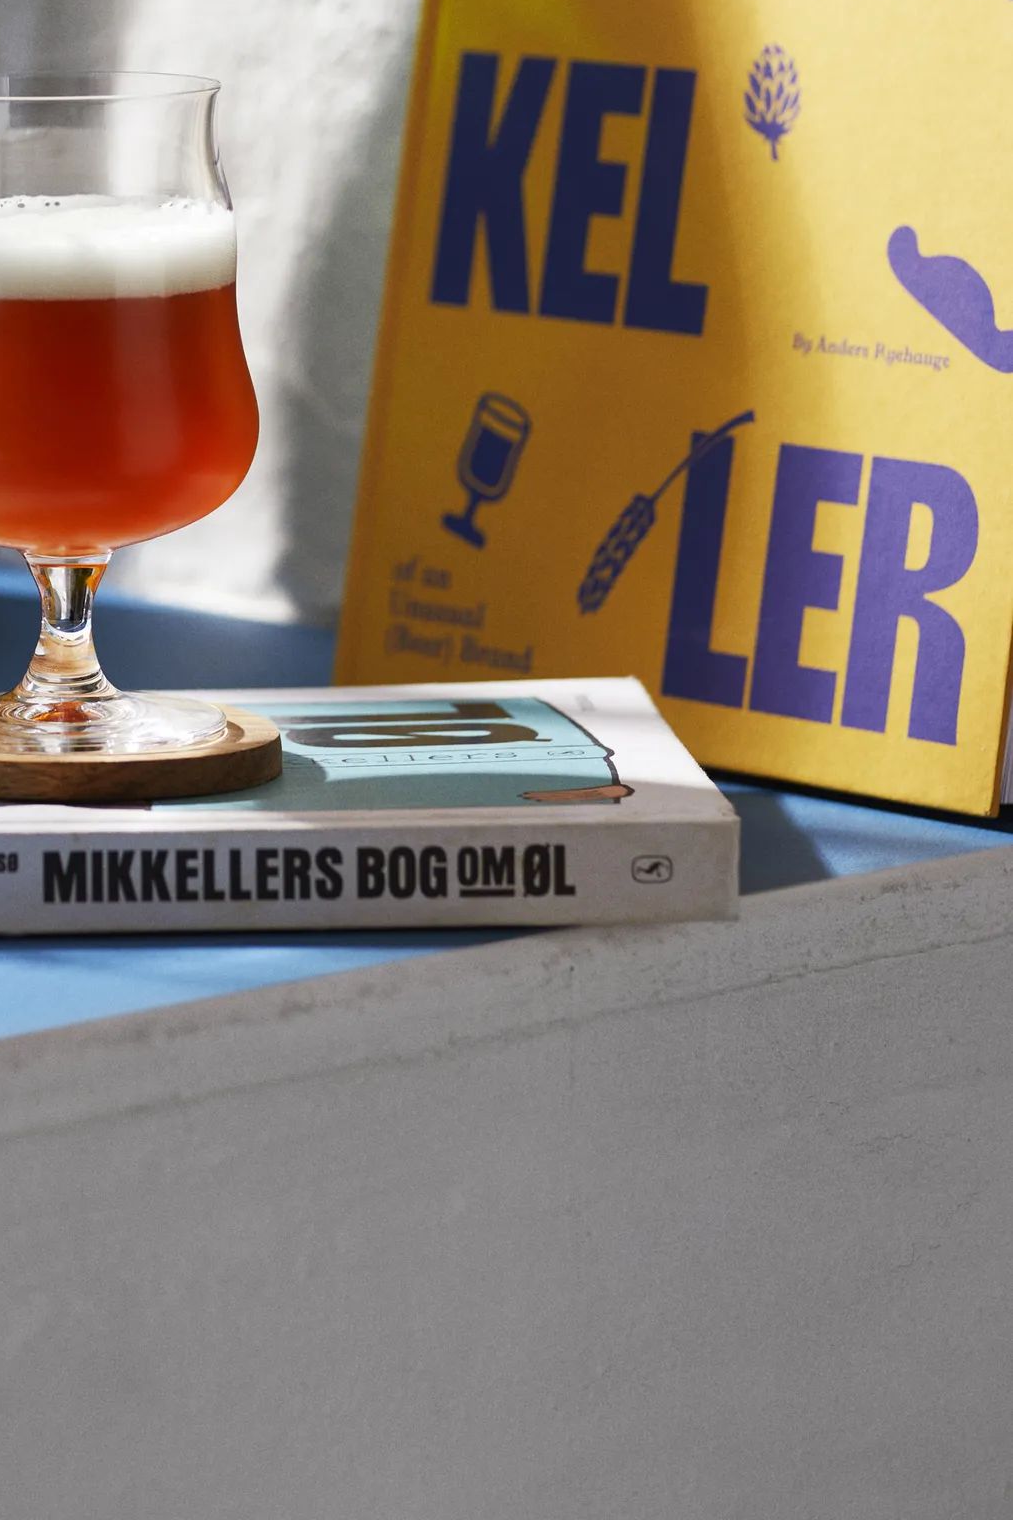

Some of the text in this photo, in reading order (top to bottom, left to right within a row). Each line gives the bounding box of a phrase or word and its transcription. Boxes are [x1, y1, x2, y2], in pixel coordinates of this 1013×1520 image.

[429, 49, 709, 338] KEL
[792, 332, 812, 354] By
[816, 335, 868, 358] Anders
[661, 430, 980, 747] LER
[42, 843, 576, 904] MIKKELLERS BOG OM ØL
